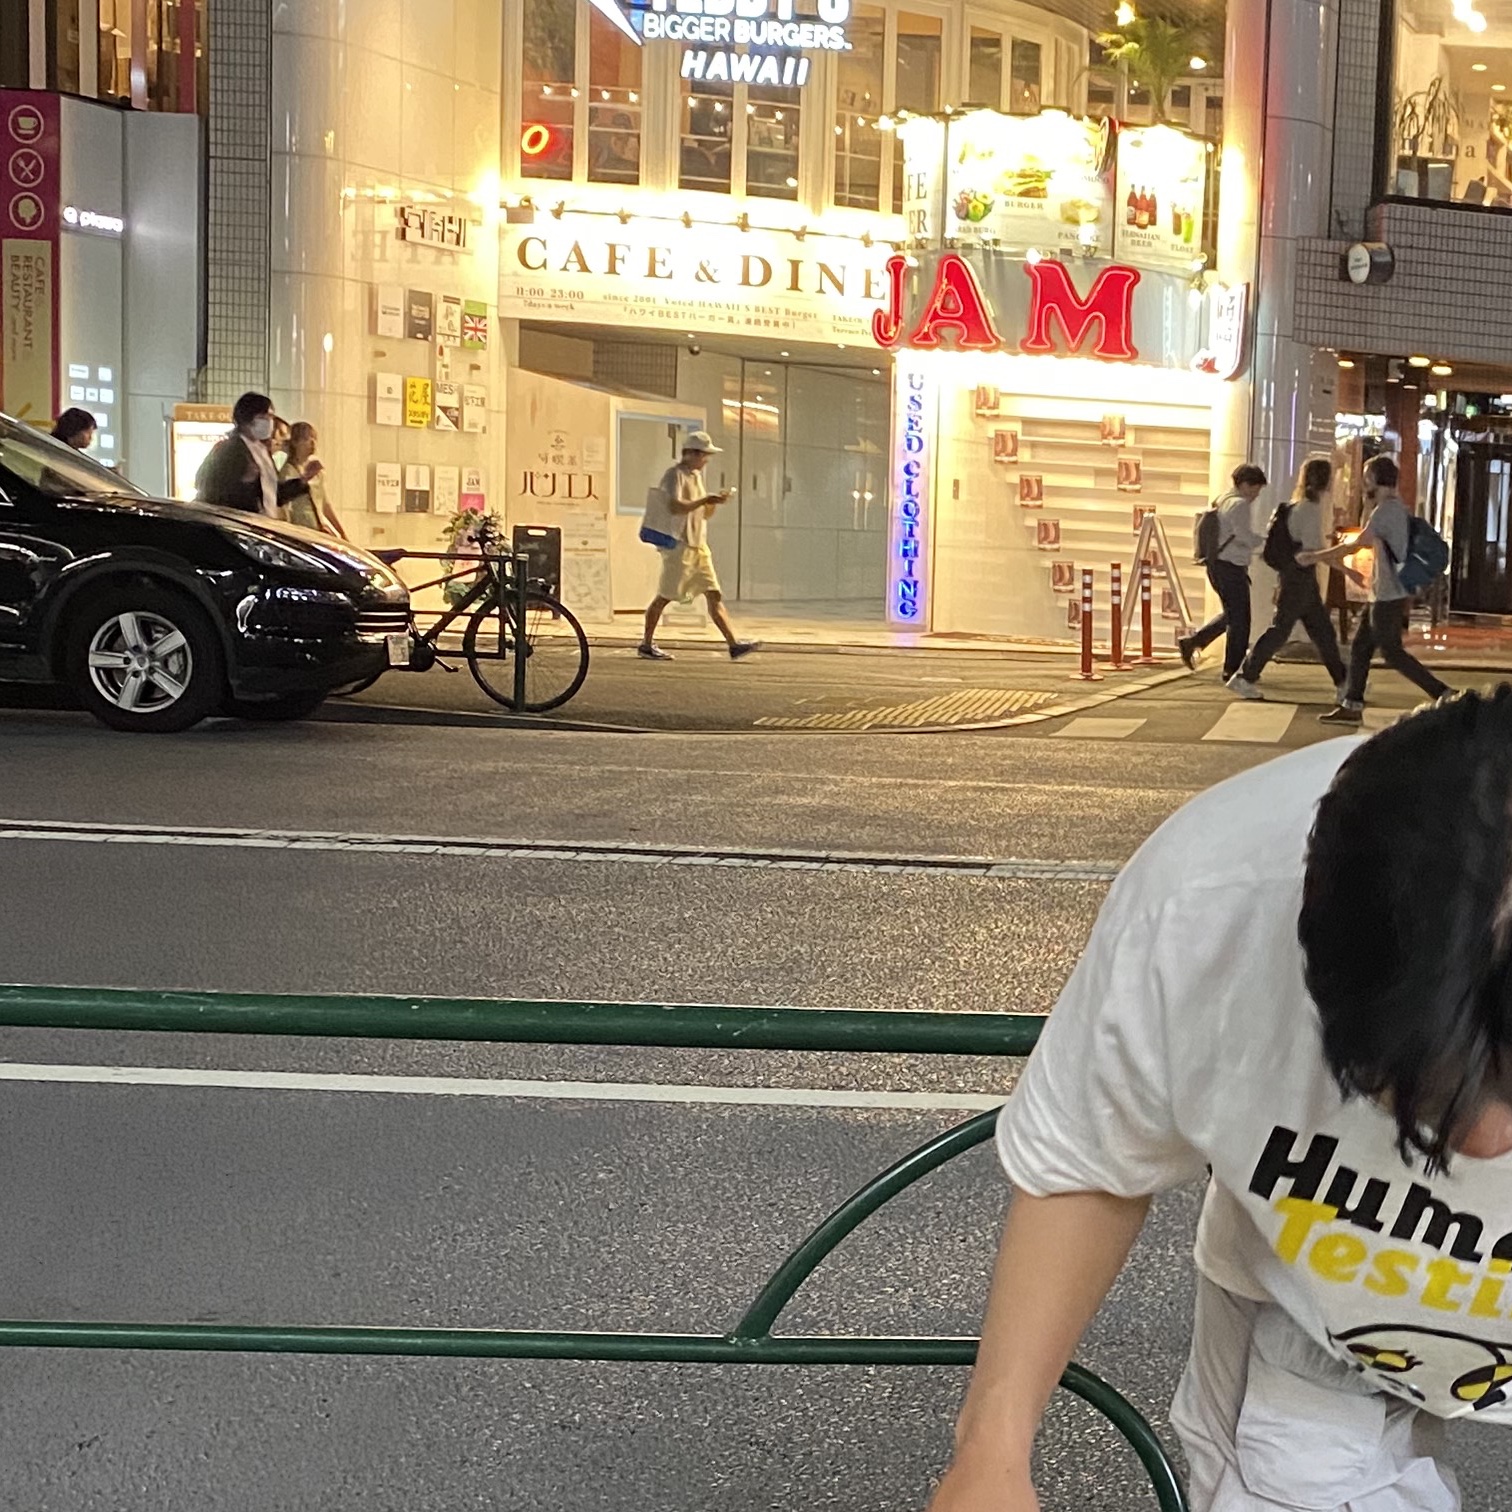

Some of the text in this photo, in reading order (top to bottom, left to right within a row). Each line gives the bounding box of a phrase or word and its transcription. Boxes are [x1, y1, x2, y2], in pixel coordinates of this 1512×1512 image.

[643, 12, 730, 42] BIGGER
[680, 50, 811, 86] HAWAII
[10, 254, 21, 315] BEAUTY
[34, 256, 45, 297] CAFE
[516, 236, 886, 301] CAFE & DINE
[550, 288, 585, 300] 23:00
[22, 255, 34, 350] RESTAURANT
[870, 253, 1142, 362] JAM
[897, 372, 924, 620] USED CLOTHING
